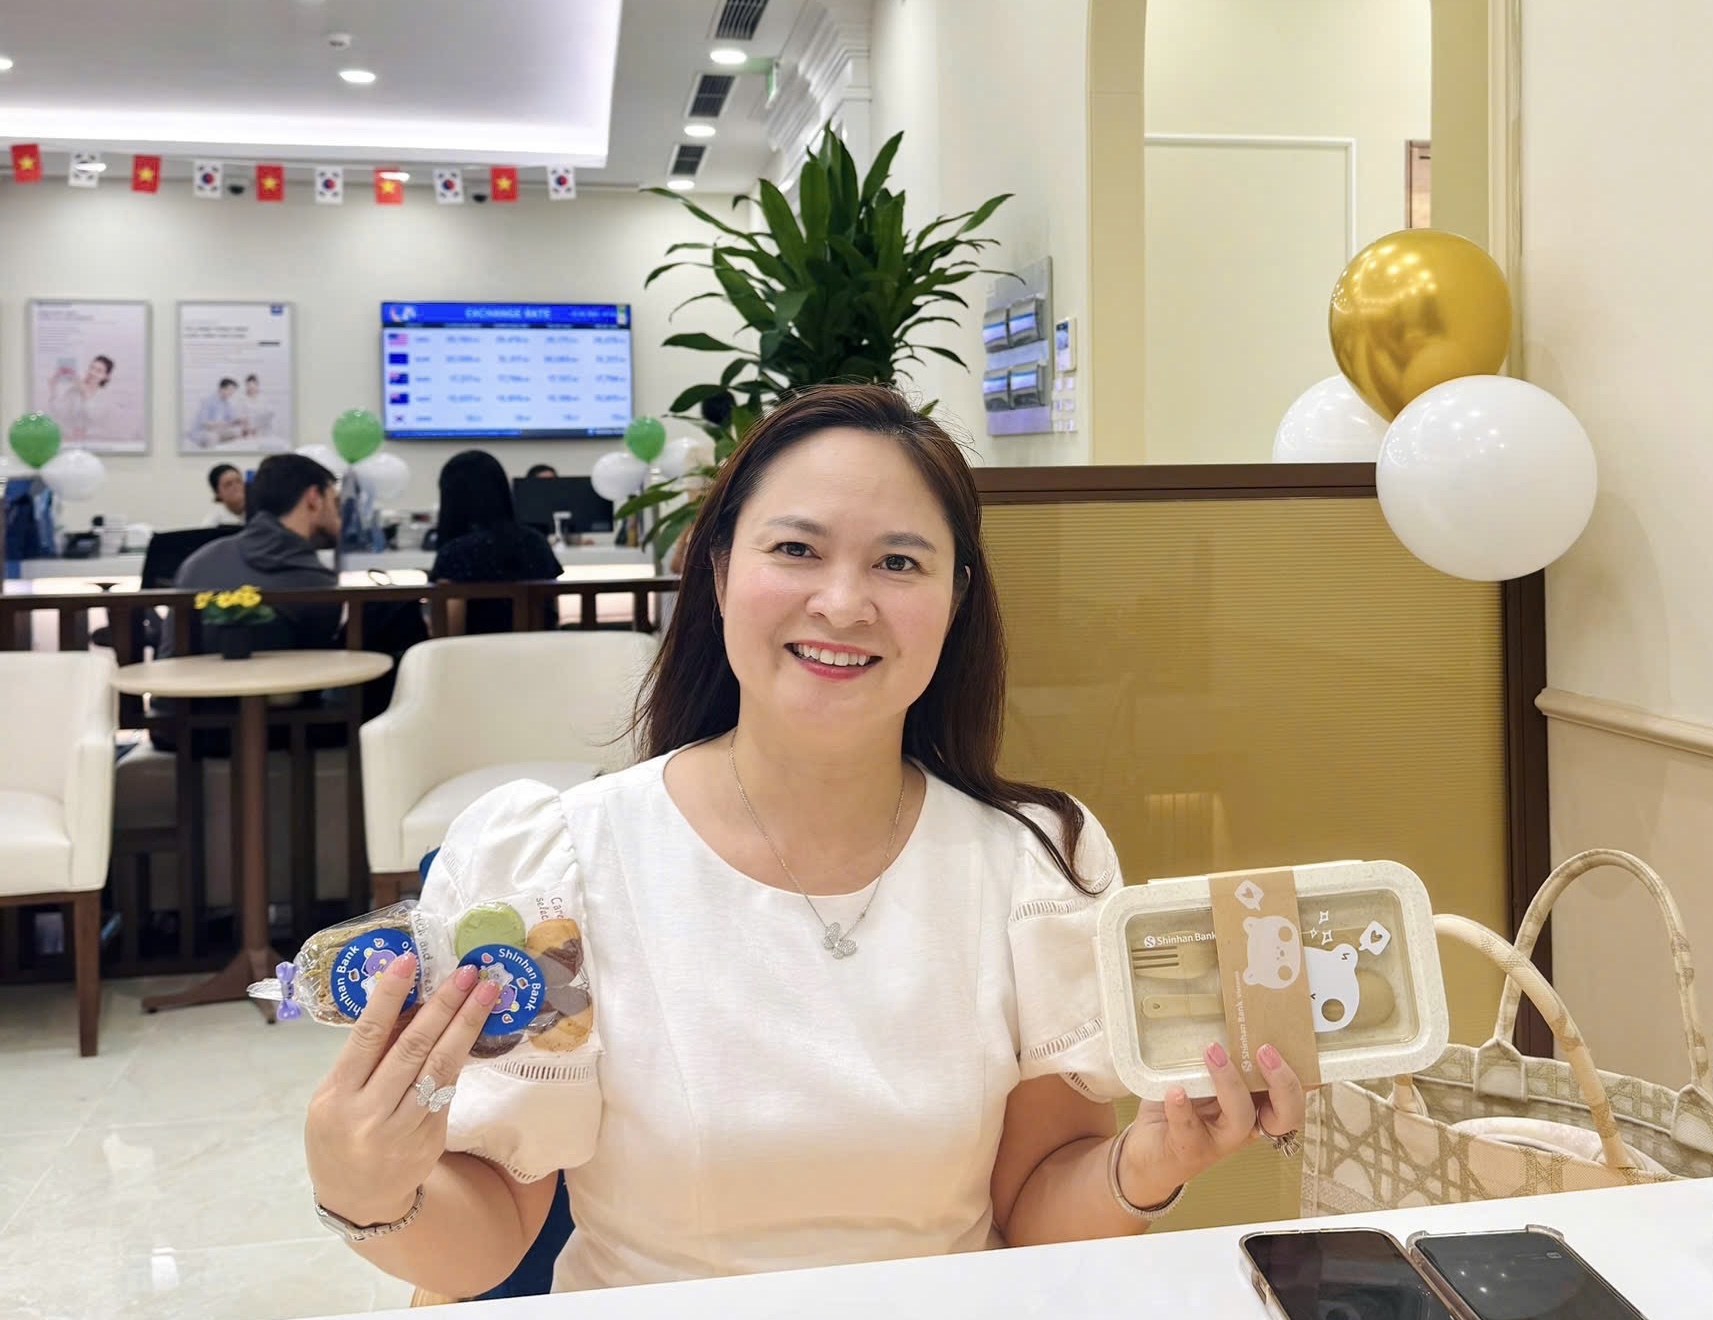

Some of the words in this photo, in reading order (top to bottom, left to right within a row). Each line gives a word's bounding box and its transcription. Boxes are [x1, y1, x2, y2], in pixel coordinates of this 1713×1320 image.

[464, 307, 521, 320] EXCHANGE
[524, 308, 552, 321] RATE
[1156, 934, 1194, 946] Shinhan
[1194, 930, 1217, 942] Bank
[336, 945, 360, 974] Bank
[498, 947, 538, 980] Shinhan
[524, 982, 542, 1012] Bank
[337, 977, 364, 1016] hinhan
[1235, 1000, 1246, 1023] Bank
[1239, 1024, 1250, 1060] Shinhan
